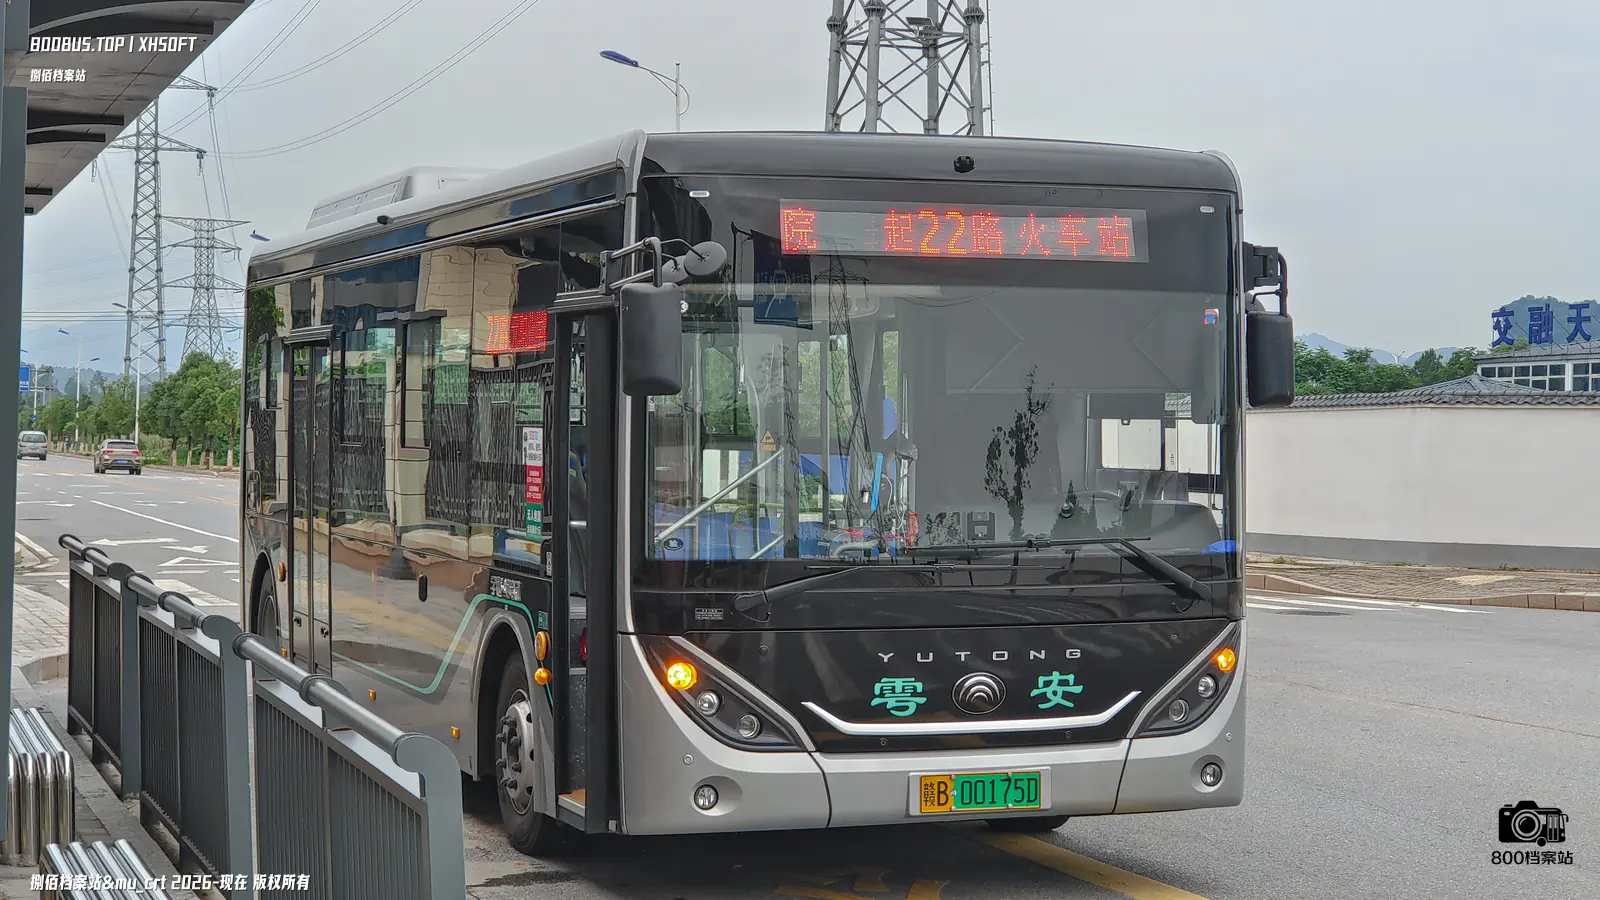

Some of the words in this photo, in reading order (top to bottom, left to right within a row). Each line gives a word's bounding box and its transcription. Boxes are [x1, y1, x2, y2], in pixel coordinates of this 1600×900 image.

[1020, 213, 1130, 257] 火车站
[877, 649, 1082, 663] YUTONG
